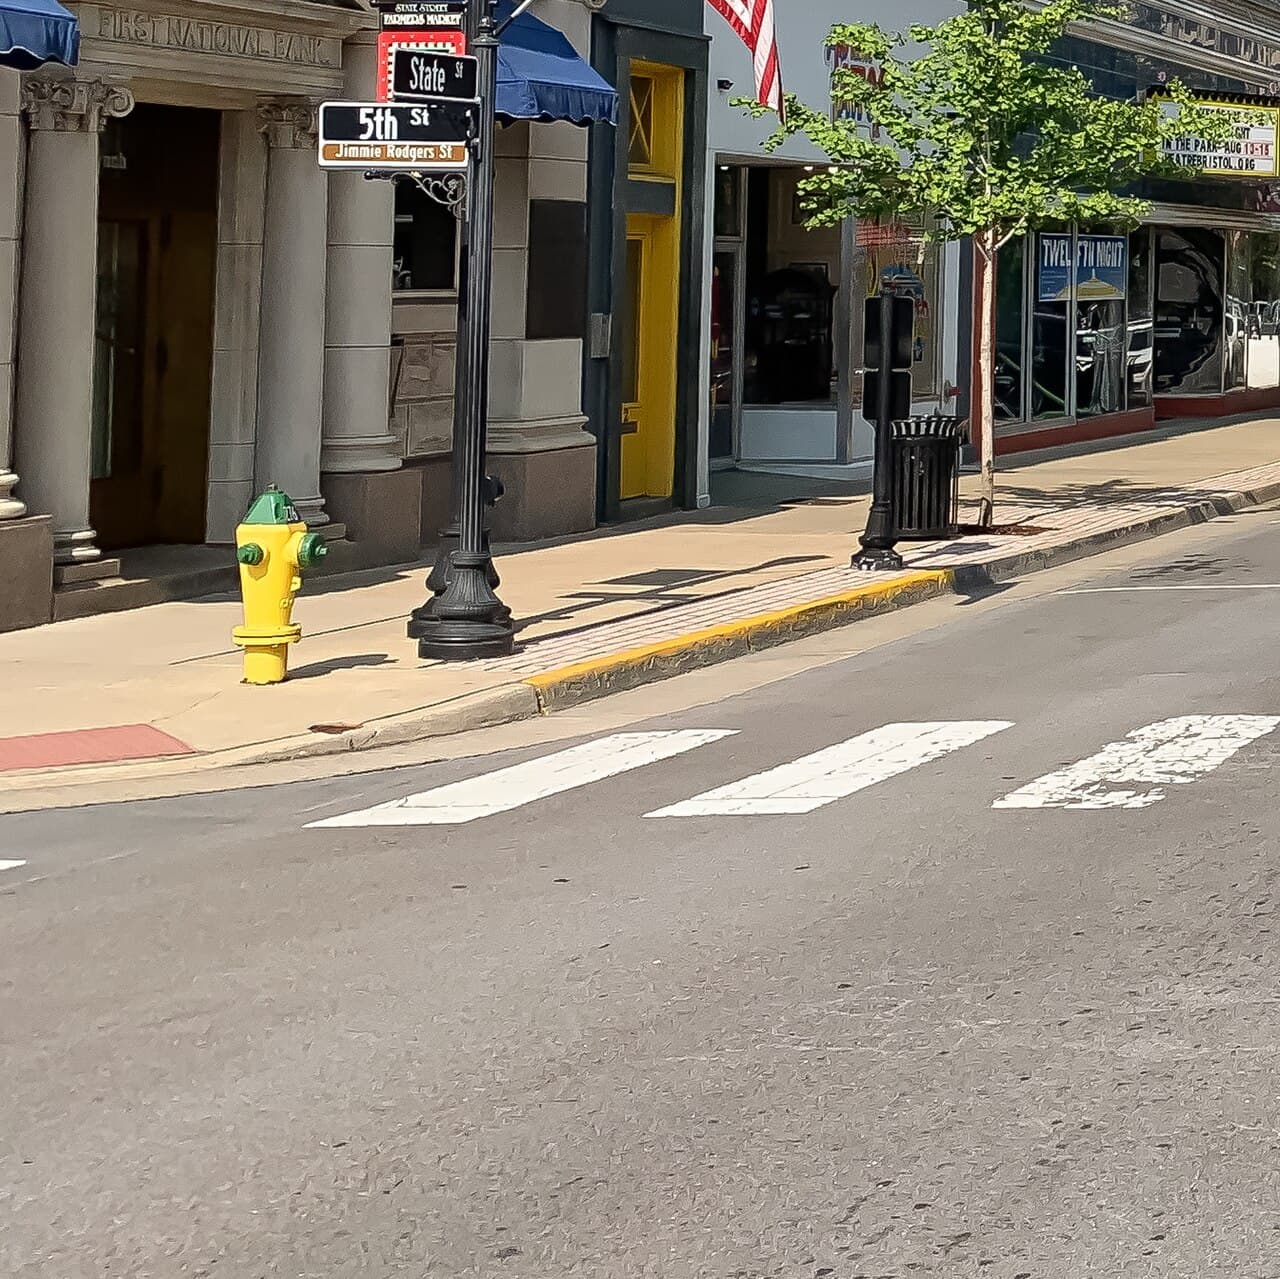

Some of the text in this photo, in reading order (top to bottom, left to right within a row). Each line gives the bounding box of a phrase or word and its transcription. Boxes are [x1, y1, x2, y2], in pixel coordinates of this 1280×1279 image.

[395, 3, 418, 13] STATE
[384, 14, 461, 25] FARMERS MARKET
[98, 9, 330, 65] FIRST NATIONAL BANK
[409, 56, 464, 93] State St
[359, 108, 430, 140] 5th St
[335, 144, 452, 162] Jimmie Rodgers St
[1175, 139, 1191, 152] THE
[1225, 141, 1242, 154] AUG
[1096, 241, 1124, 268] NIGHT
